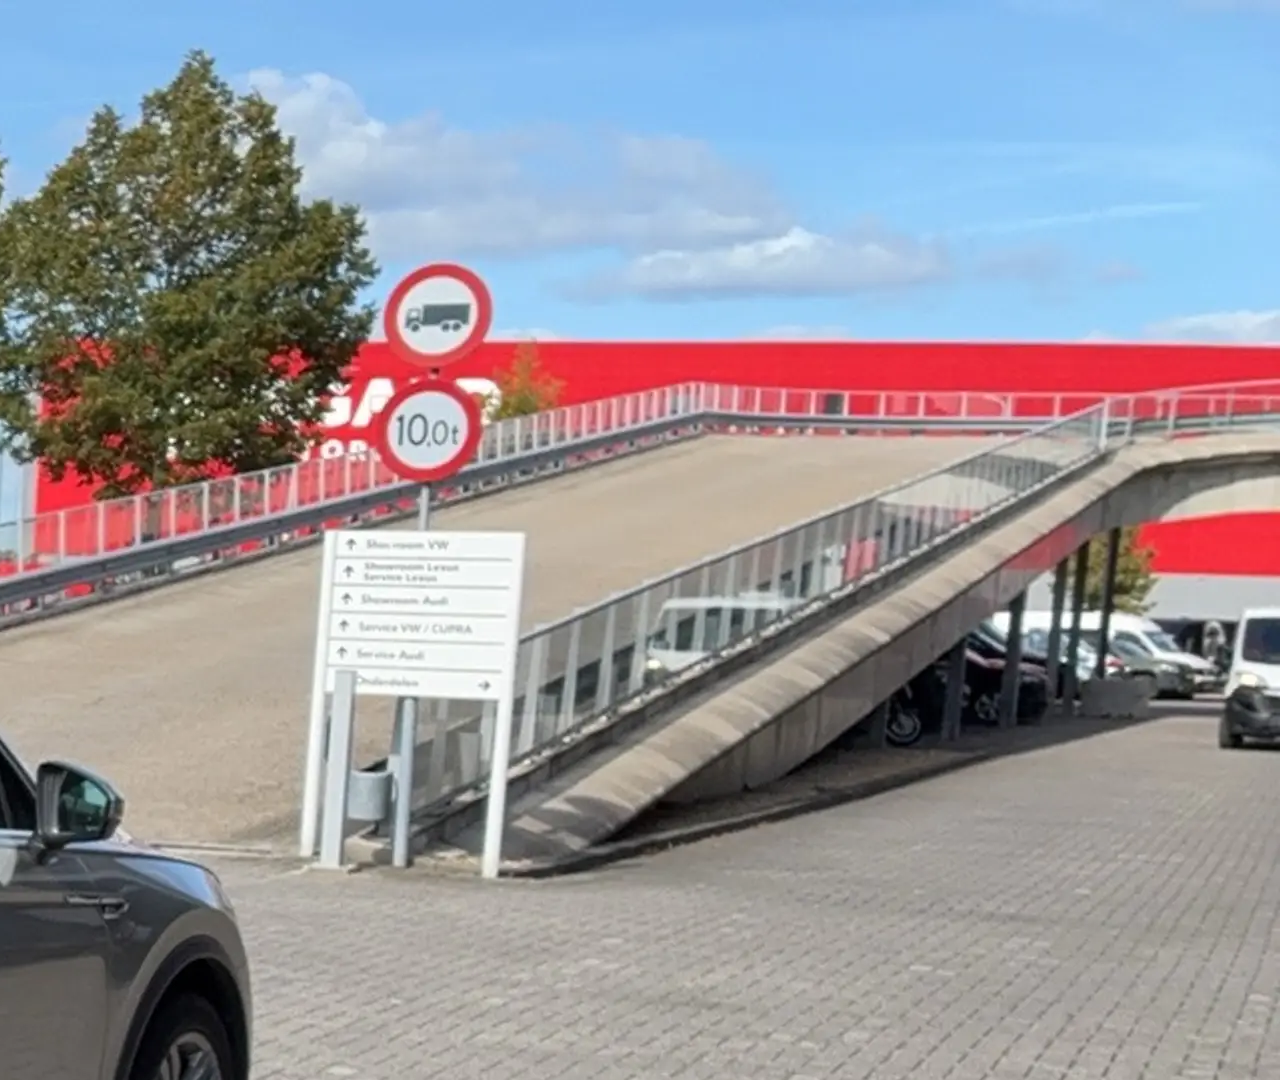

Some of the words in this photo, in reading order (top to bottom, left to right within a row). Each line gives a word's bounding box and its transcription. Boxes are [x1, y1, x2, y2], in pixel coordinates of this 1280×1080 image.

[428, 540, 450, 551] VW
[361, 594, 419, 605] Showroom
[422, 595, 449, 606] Audi
[359, 622, 398, 633] Service
[401, 624, 422, 634] VW
[432, 624, 473, 635] CUPRA
[357, 650, 396, 660] Service
[399, 650, 425, 661] Audi
